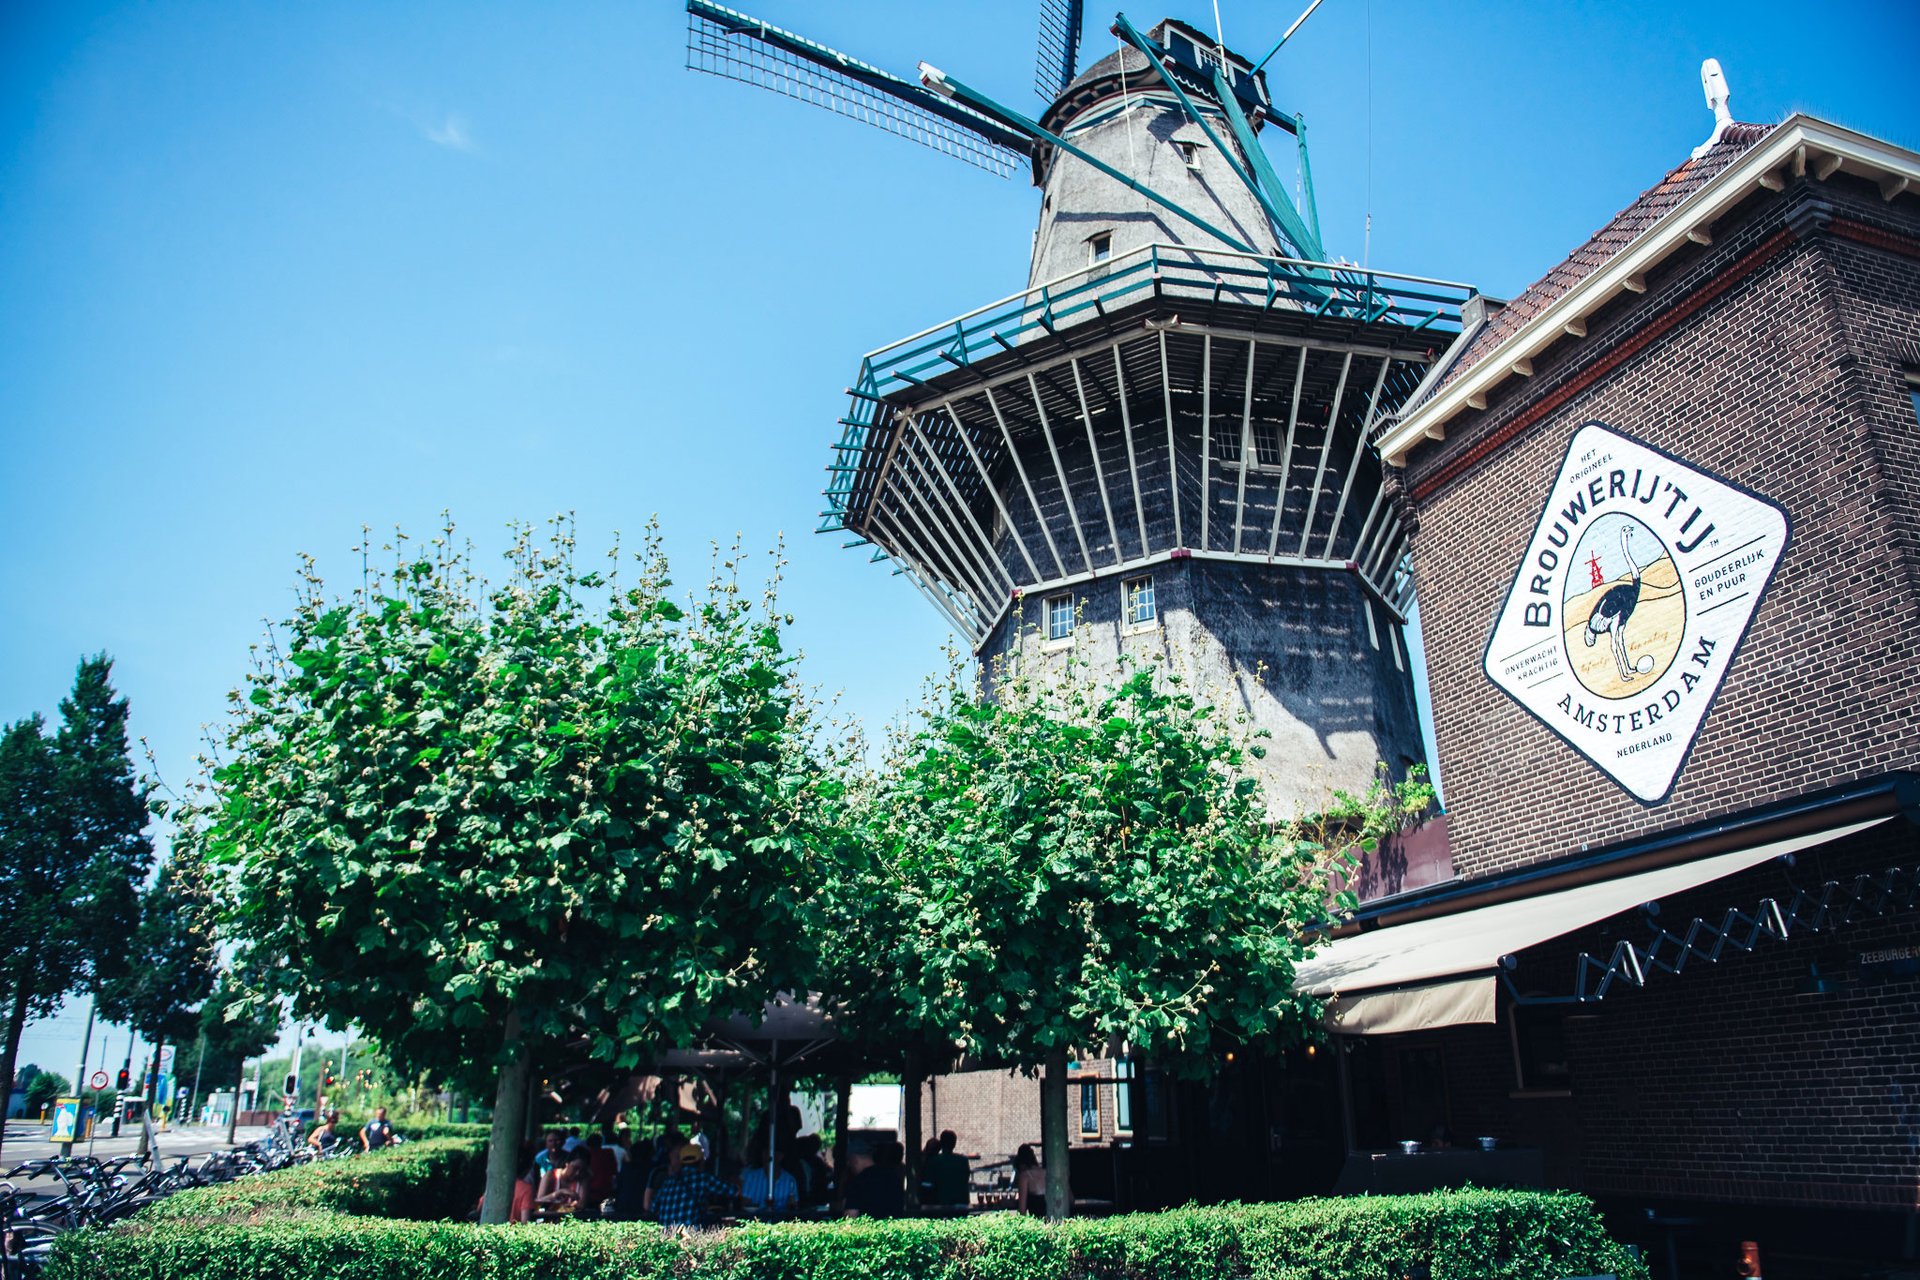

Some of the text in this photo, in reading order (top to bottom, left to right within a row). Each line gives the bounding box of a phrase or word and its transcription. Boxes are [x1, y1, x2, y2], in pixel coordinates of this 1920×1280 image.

[1570, 453, 1613, 483] ORIGINEEL
[1580, 449, 1596, 463] HET
[1694, 549, 1765, 588] GOUDEERLIJK
[1699, 573, 1746, 601] EN PUUR
[1505, 645, 1557, 675] ONVERWACHT
[1517, 657, 1558, 681] KRACHTIG
[1557, 636, 1716, 734] AMSTERDAM
[1616, 732, 1673, 758] NEDERLAND
